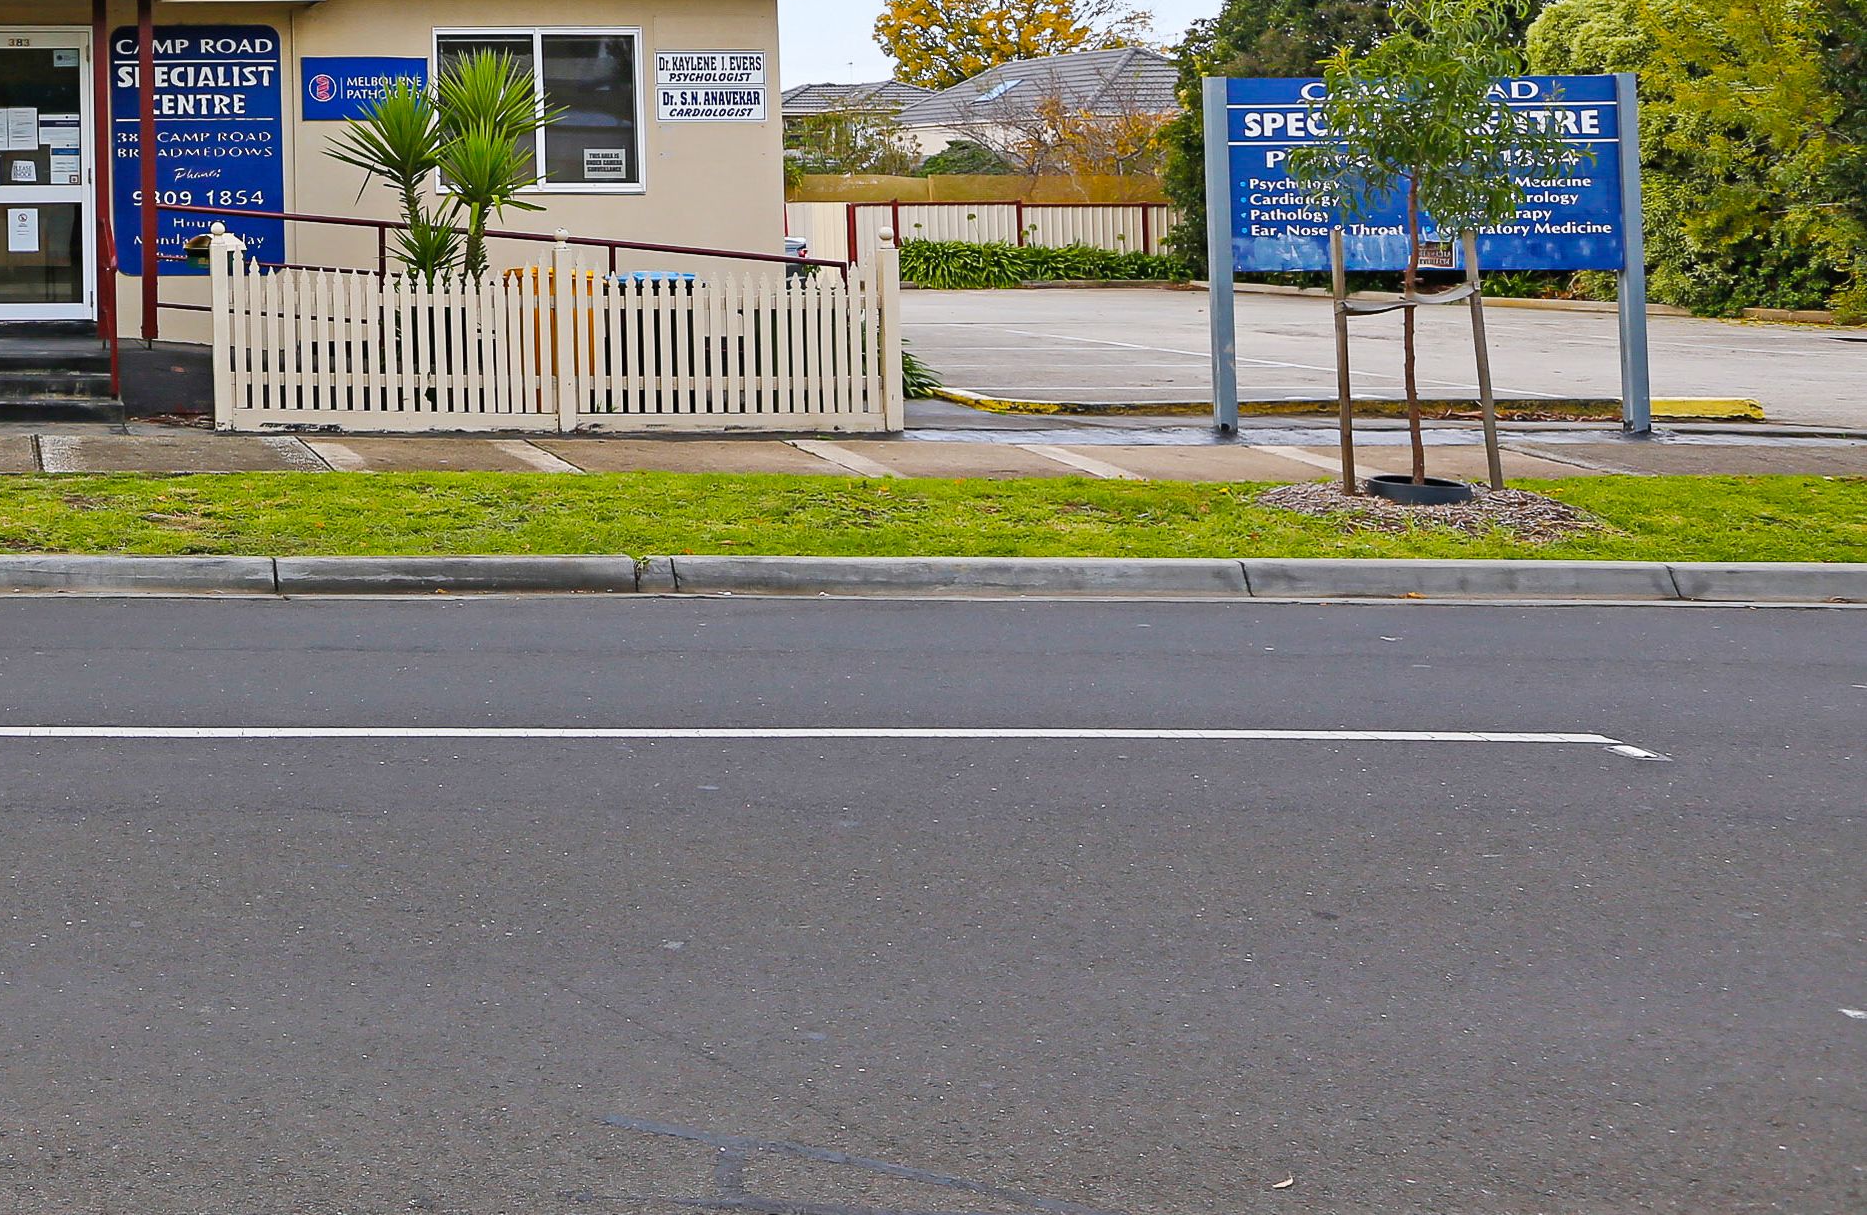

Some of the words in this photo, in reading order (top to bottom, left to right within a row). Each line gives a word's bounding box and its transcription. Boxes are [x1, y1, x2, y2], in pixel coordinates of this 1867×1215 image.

[8, 38, 30, 47] 383
[200, 38, 273, 54] ROAD
[659, 56, 671, 71] Dr.
[672, 56, 717, 71] KAYLENE
[729, 56, 762, 71] EVERS
[117, 66, 274, 88] SECIALIST
[669, 73, 752, 82] PSYCHOLOGIST
[662, 91, 677, 106] Dr.
[704, 91, 761, 106] ANAVEKAR
[669, 107, 754, 117] CARDIOLOGIST
[117, 132, 139, 143] 38
[157, 131, 210, 143] CAMP
[217, 131, 272, 142] ROAD
[117, 146, 273, 158] BRADMEDOWS
[1249, 178, 1340, 192] Psychlogy
[206, 189, 264, 206] 1854
[1251, 224, 1282, 237] Ear,
[1286, 224, 1328, 236] Nose
[1349, 224, 1404, 236] Throat
[1534, 222, 1612, 234] Medicine
